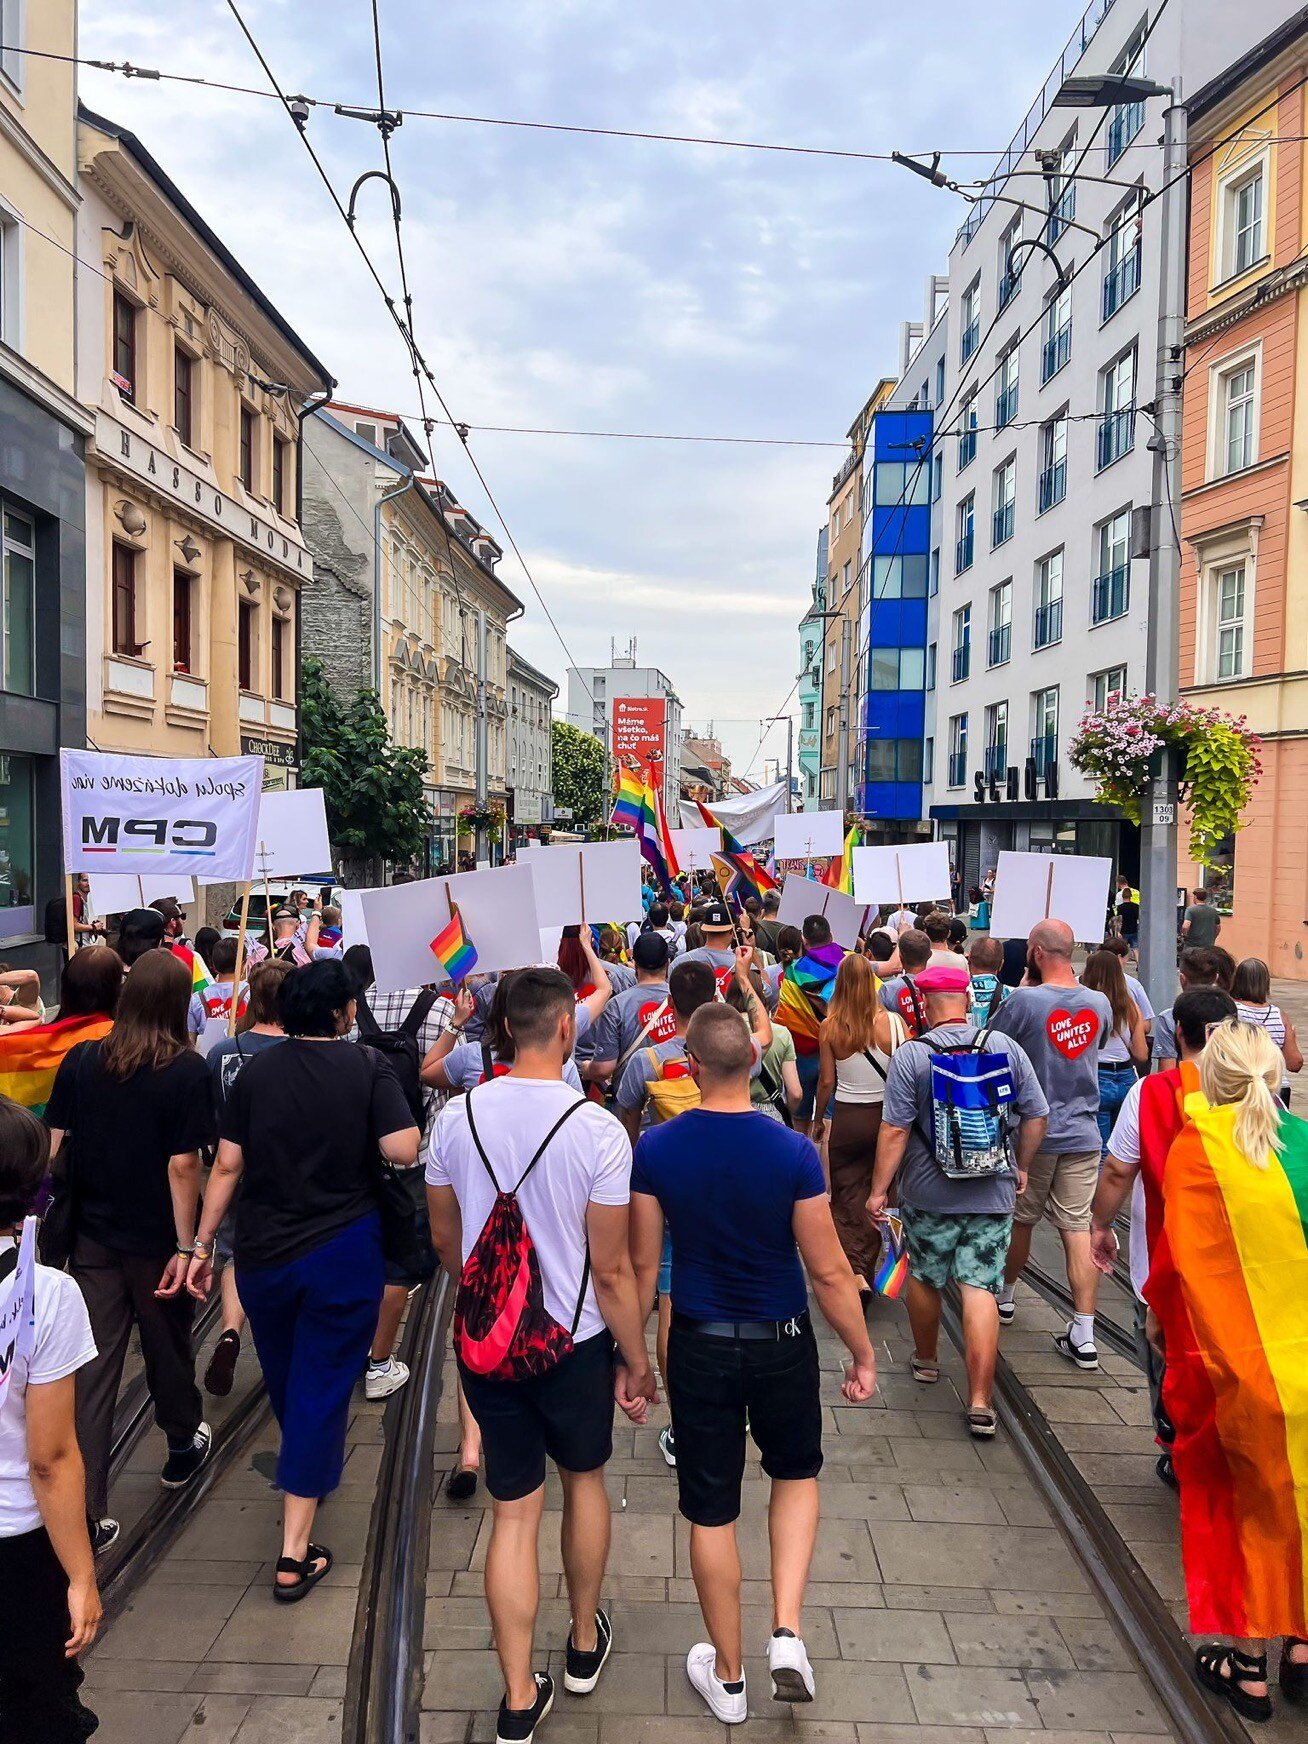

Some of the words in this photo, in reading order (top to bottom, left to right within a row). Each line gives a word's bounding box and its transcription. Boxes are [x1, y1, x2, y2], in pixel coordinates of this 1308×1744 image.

[120, 430, 222, 516] HASSO
[250, 517, 302, 568] MODA
[629, 733, 639, 741] čo
[211, 1004, 225, 1016] OVE
[1051, 1017, 1072, 1033] LOVE
[1057, 1021, 1091, 1042] UNITES
[1067, 1034, 1087, 1050] ALL!
